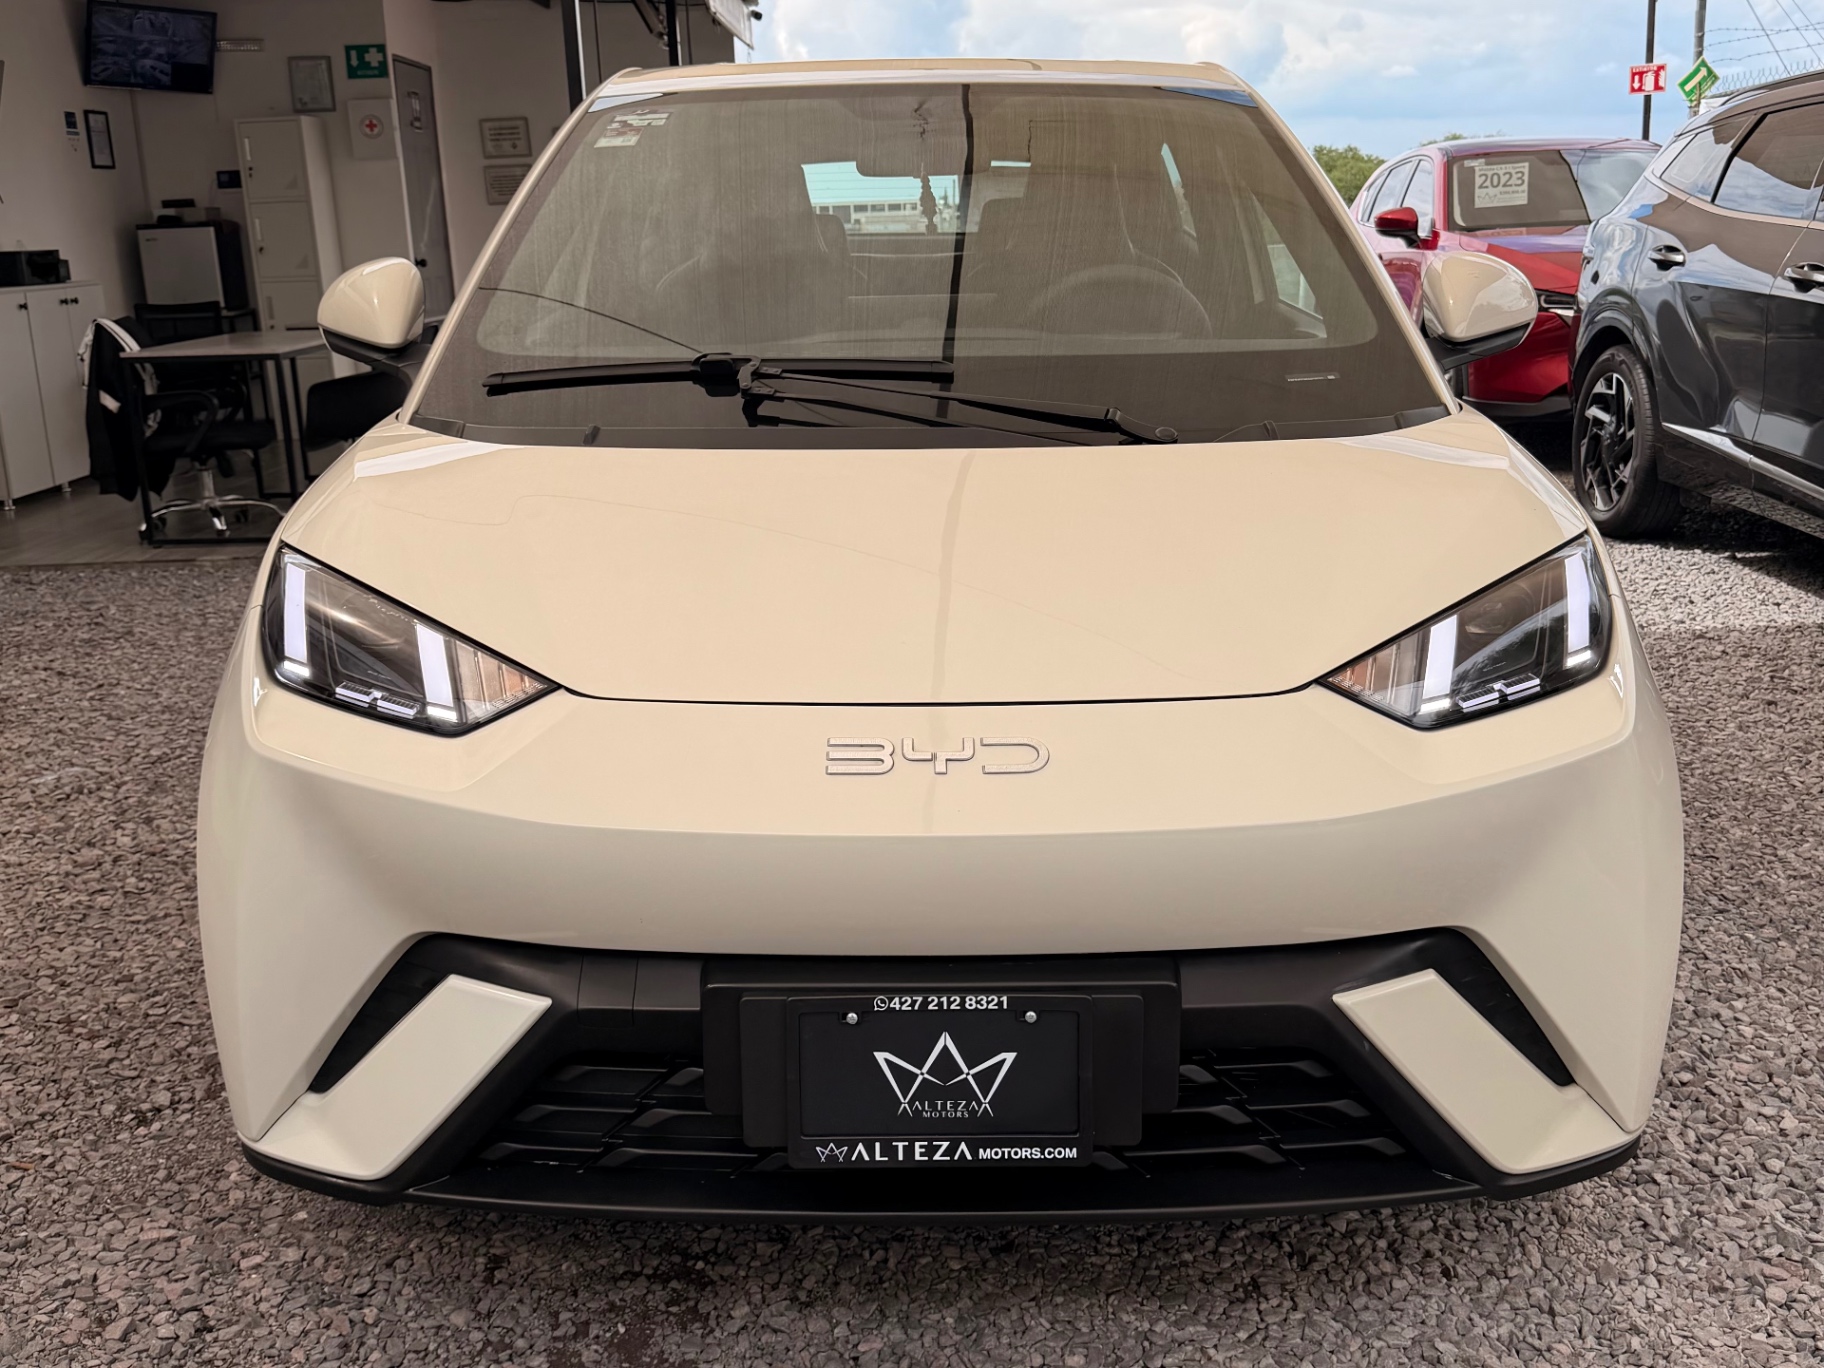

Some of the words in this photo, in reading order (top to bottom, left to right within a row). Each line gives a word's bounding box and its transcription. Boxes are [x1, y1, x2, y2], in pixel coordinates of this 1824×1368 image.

[1477, 171, 1525, 189] 2023
[825, 737, 1050, 775] BYD
[890, 996, 923, 1010] 427
[927, 997, 961, 1010] 212
[965, 996, 1008, 1010] 8321
[912, 1100, 979, 1111] ALTEZA
[851, 1141, 973, 1161] ALTEZA
[978, 1147, 1077, 1160] MOTORS.COM
